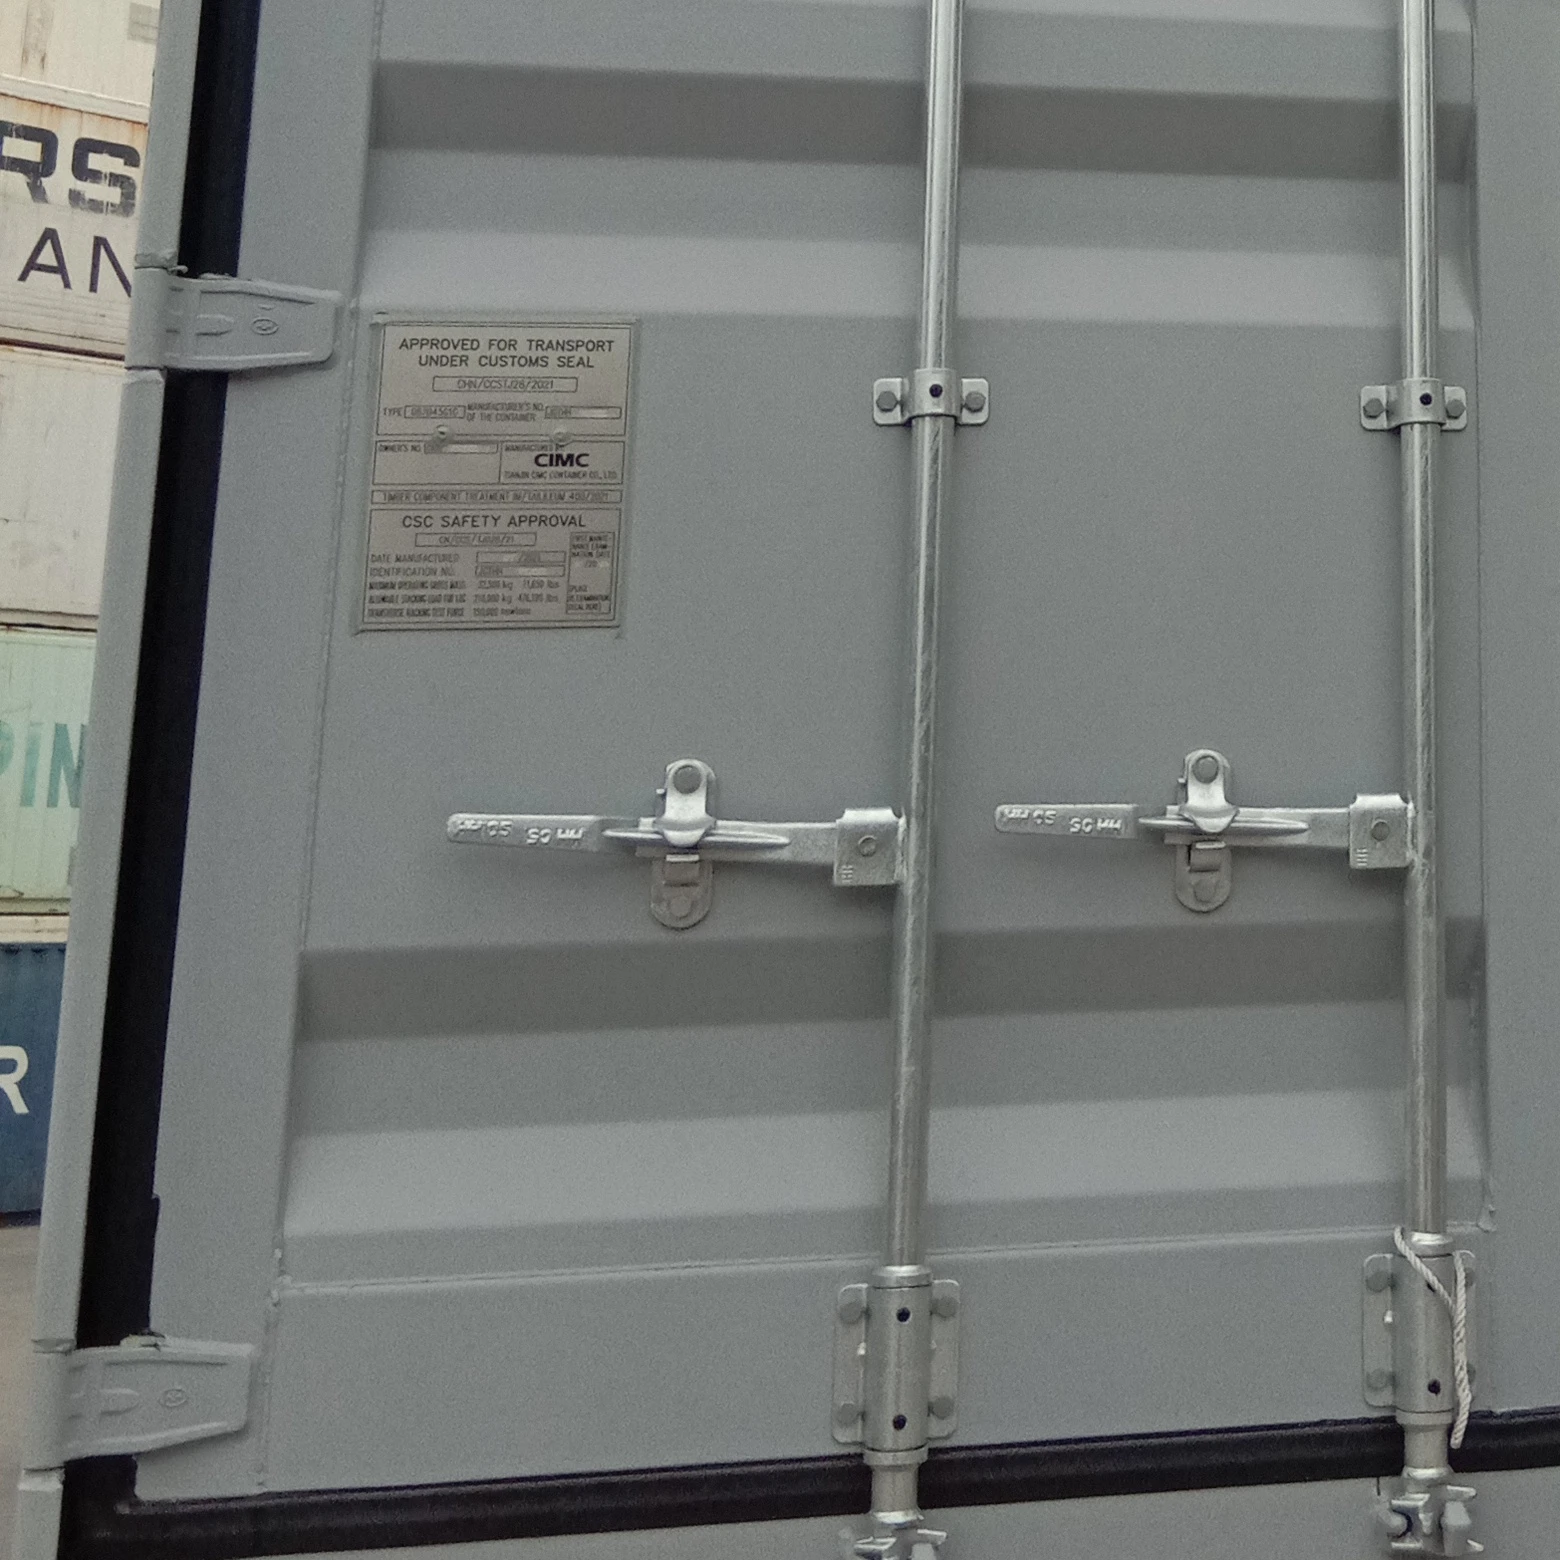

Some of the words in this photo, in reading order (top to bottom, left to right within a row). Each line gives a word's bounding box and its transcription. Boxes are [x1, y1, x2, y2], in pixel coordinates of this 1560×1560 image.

[398, 338, 480, 351] APPROVED
[488, 339, 518, 351] FOR
[527, 340, 615, 352] TRANSPORT
[418, 355, 469, 367] UNDER
[478, 355, 549, 368] CUSTOMS
[557, 356, 595, 368] SEAL
[534, 453, 590, 468] CIMC
[402, 514, 434, 528] CSC
[441, 514, 501, 528] SAFETY
[507, 514, 586, 528] APPROVAL
